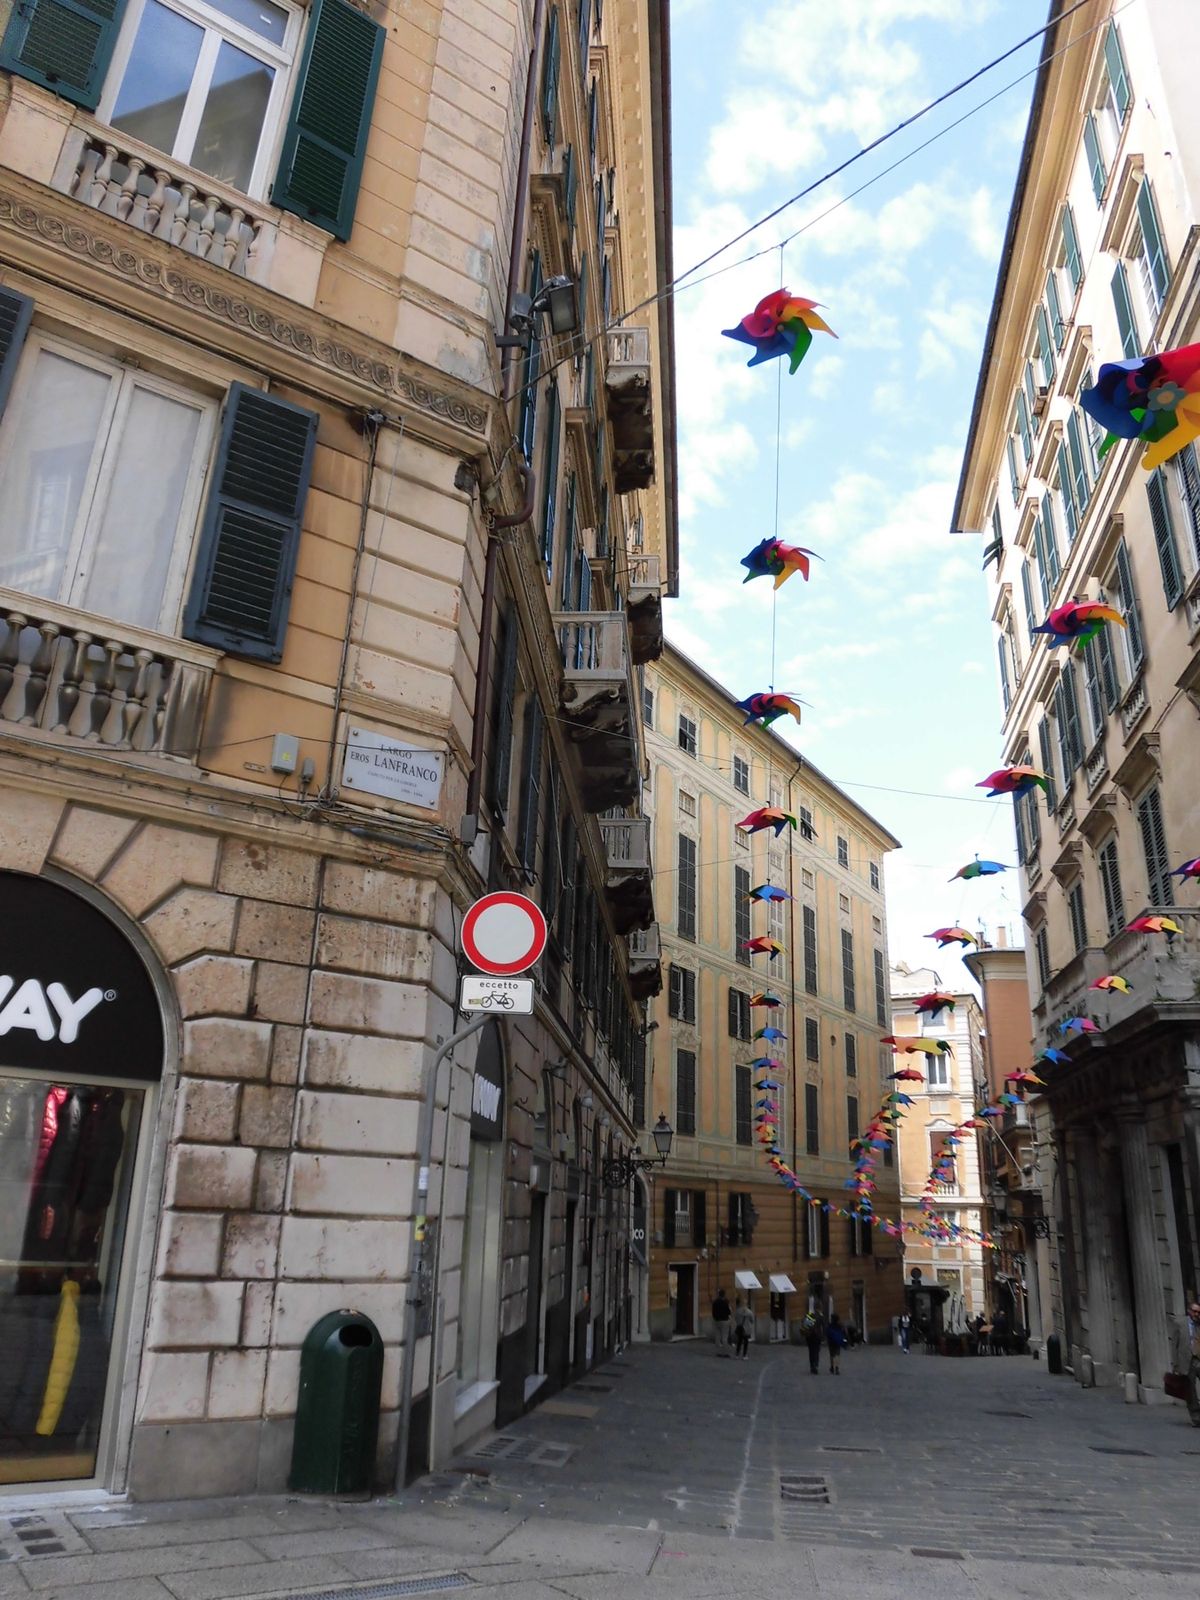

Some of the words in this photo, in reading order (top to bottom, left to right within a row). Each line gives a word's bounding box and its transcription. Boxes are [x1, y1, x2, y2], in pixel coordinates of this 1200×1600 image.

[381, 744, 412, 759] LARGO
[351, 751, 369, 764] EROS
[375, 755, 438, 782] LANFRANCO
[480, 981, 519, 990] eccetto
